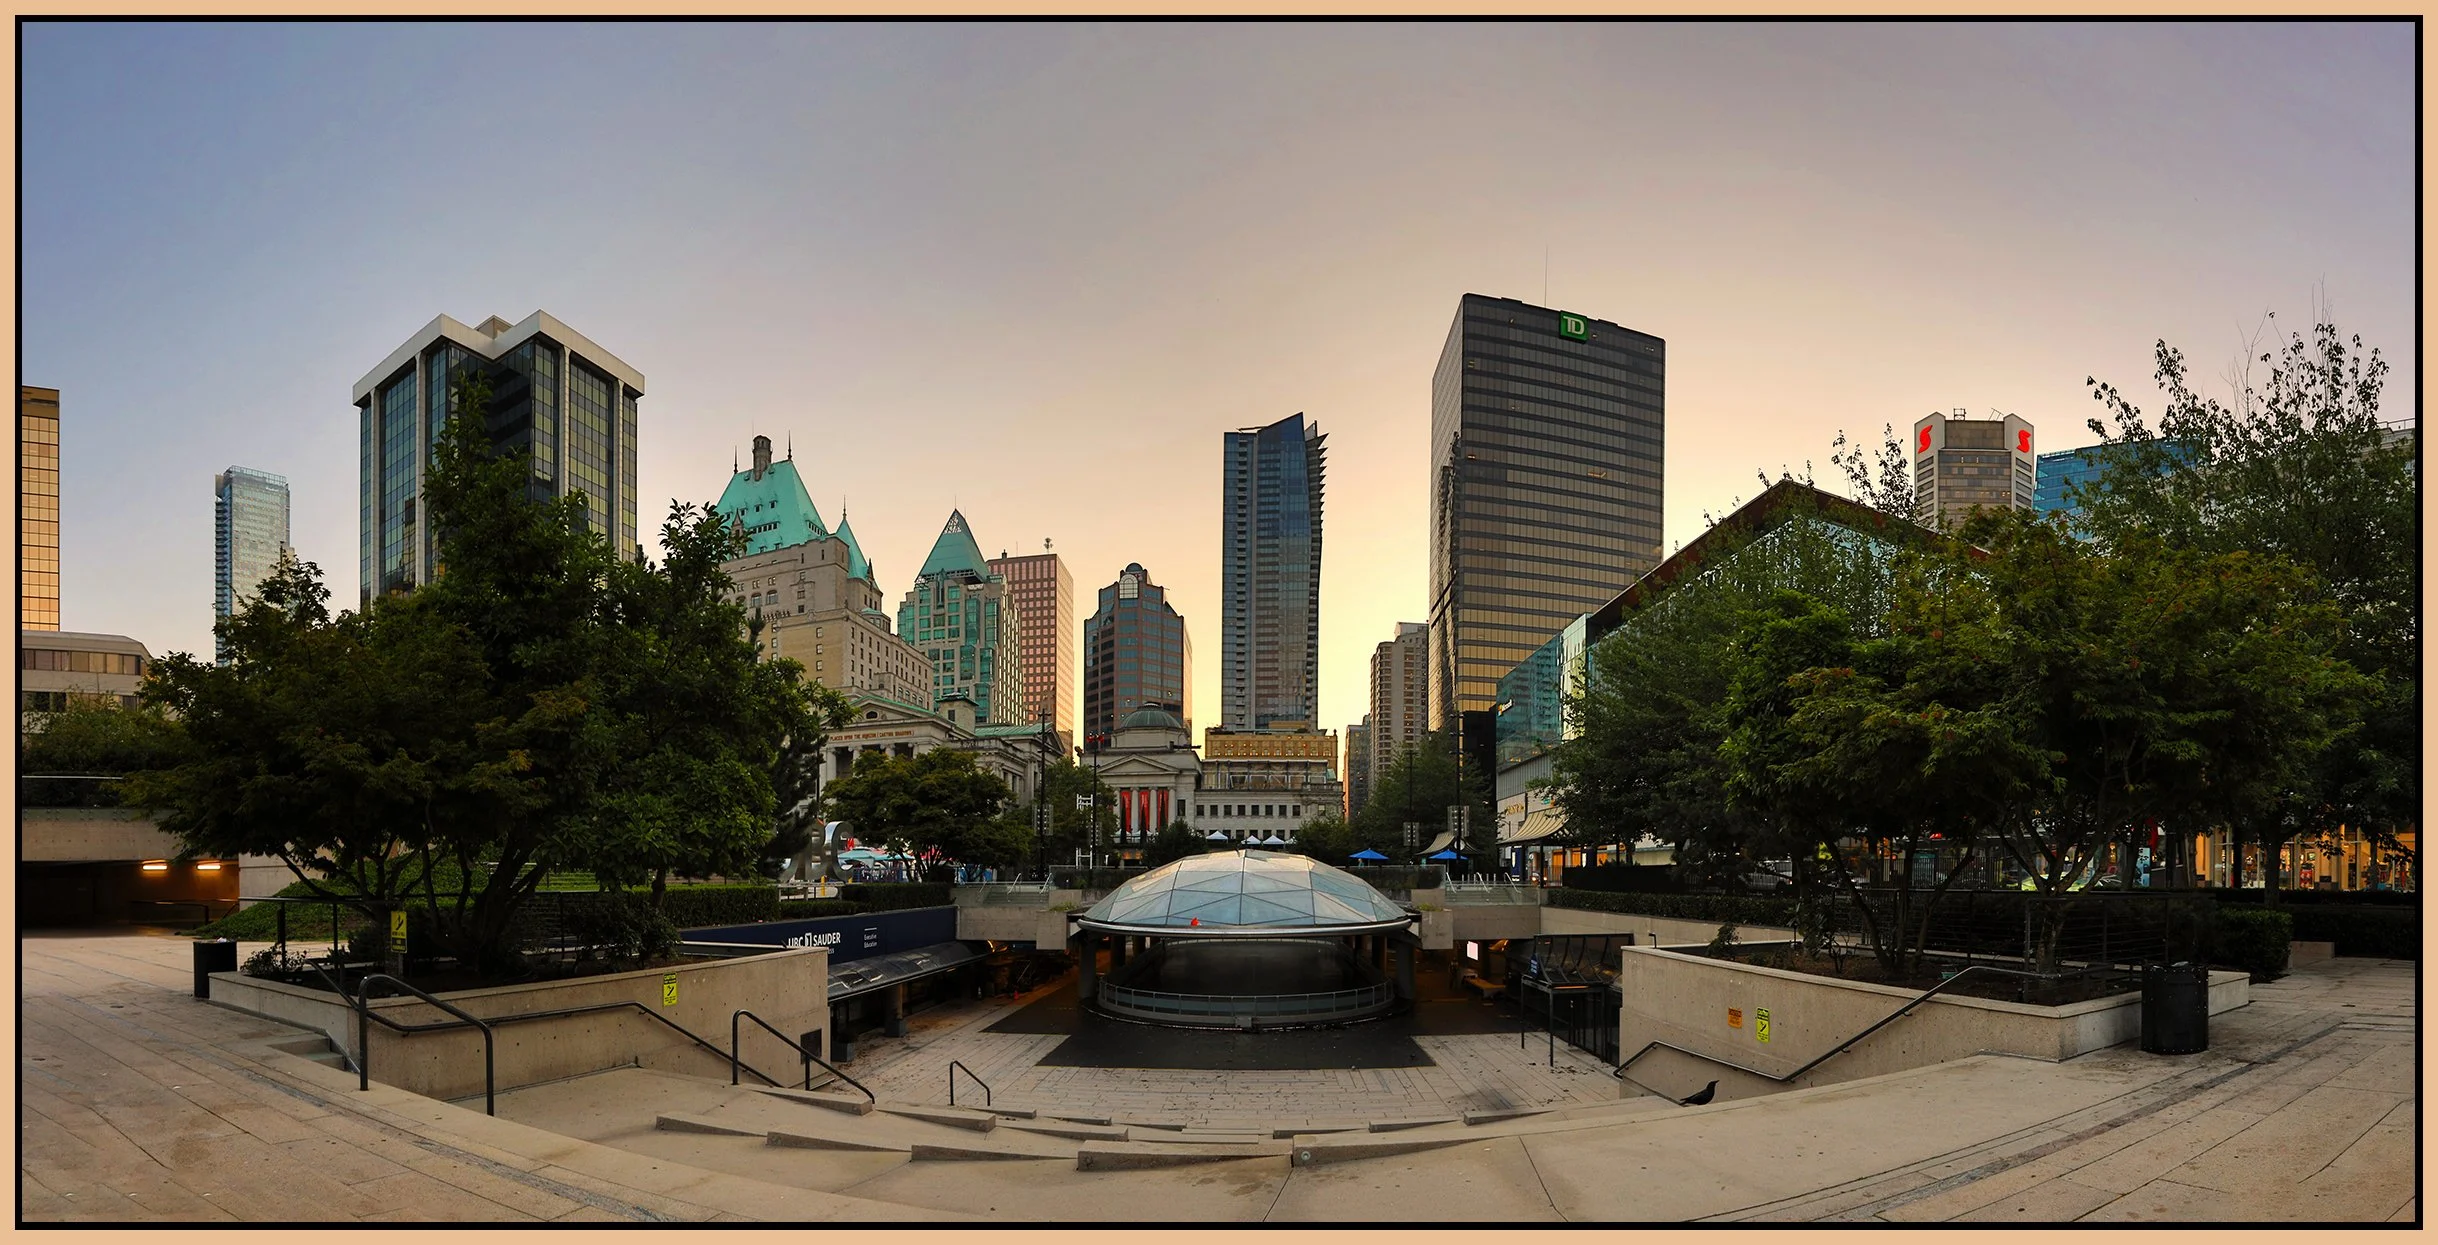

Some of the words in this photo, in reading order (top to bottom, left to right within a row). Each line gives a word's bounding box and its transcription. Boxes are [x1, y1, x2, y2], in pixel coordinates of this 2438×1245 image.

[1563, 315, 1585, 335] TD
[788, 936, 804, 947] UBC
[813, 932, 841, 947] SAUDER
